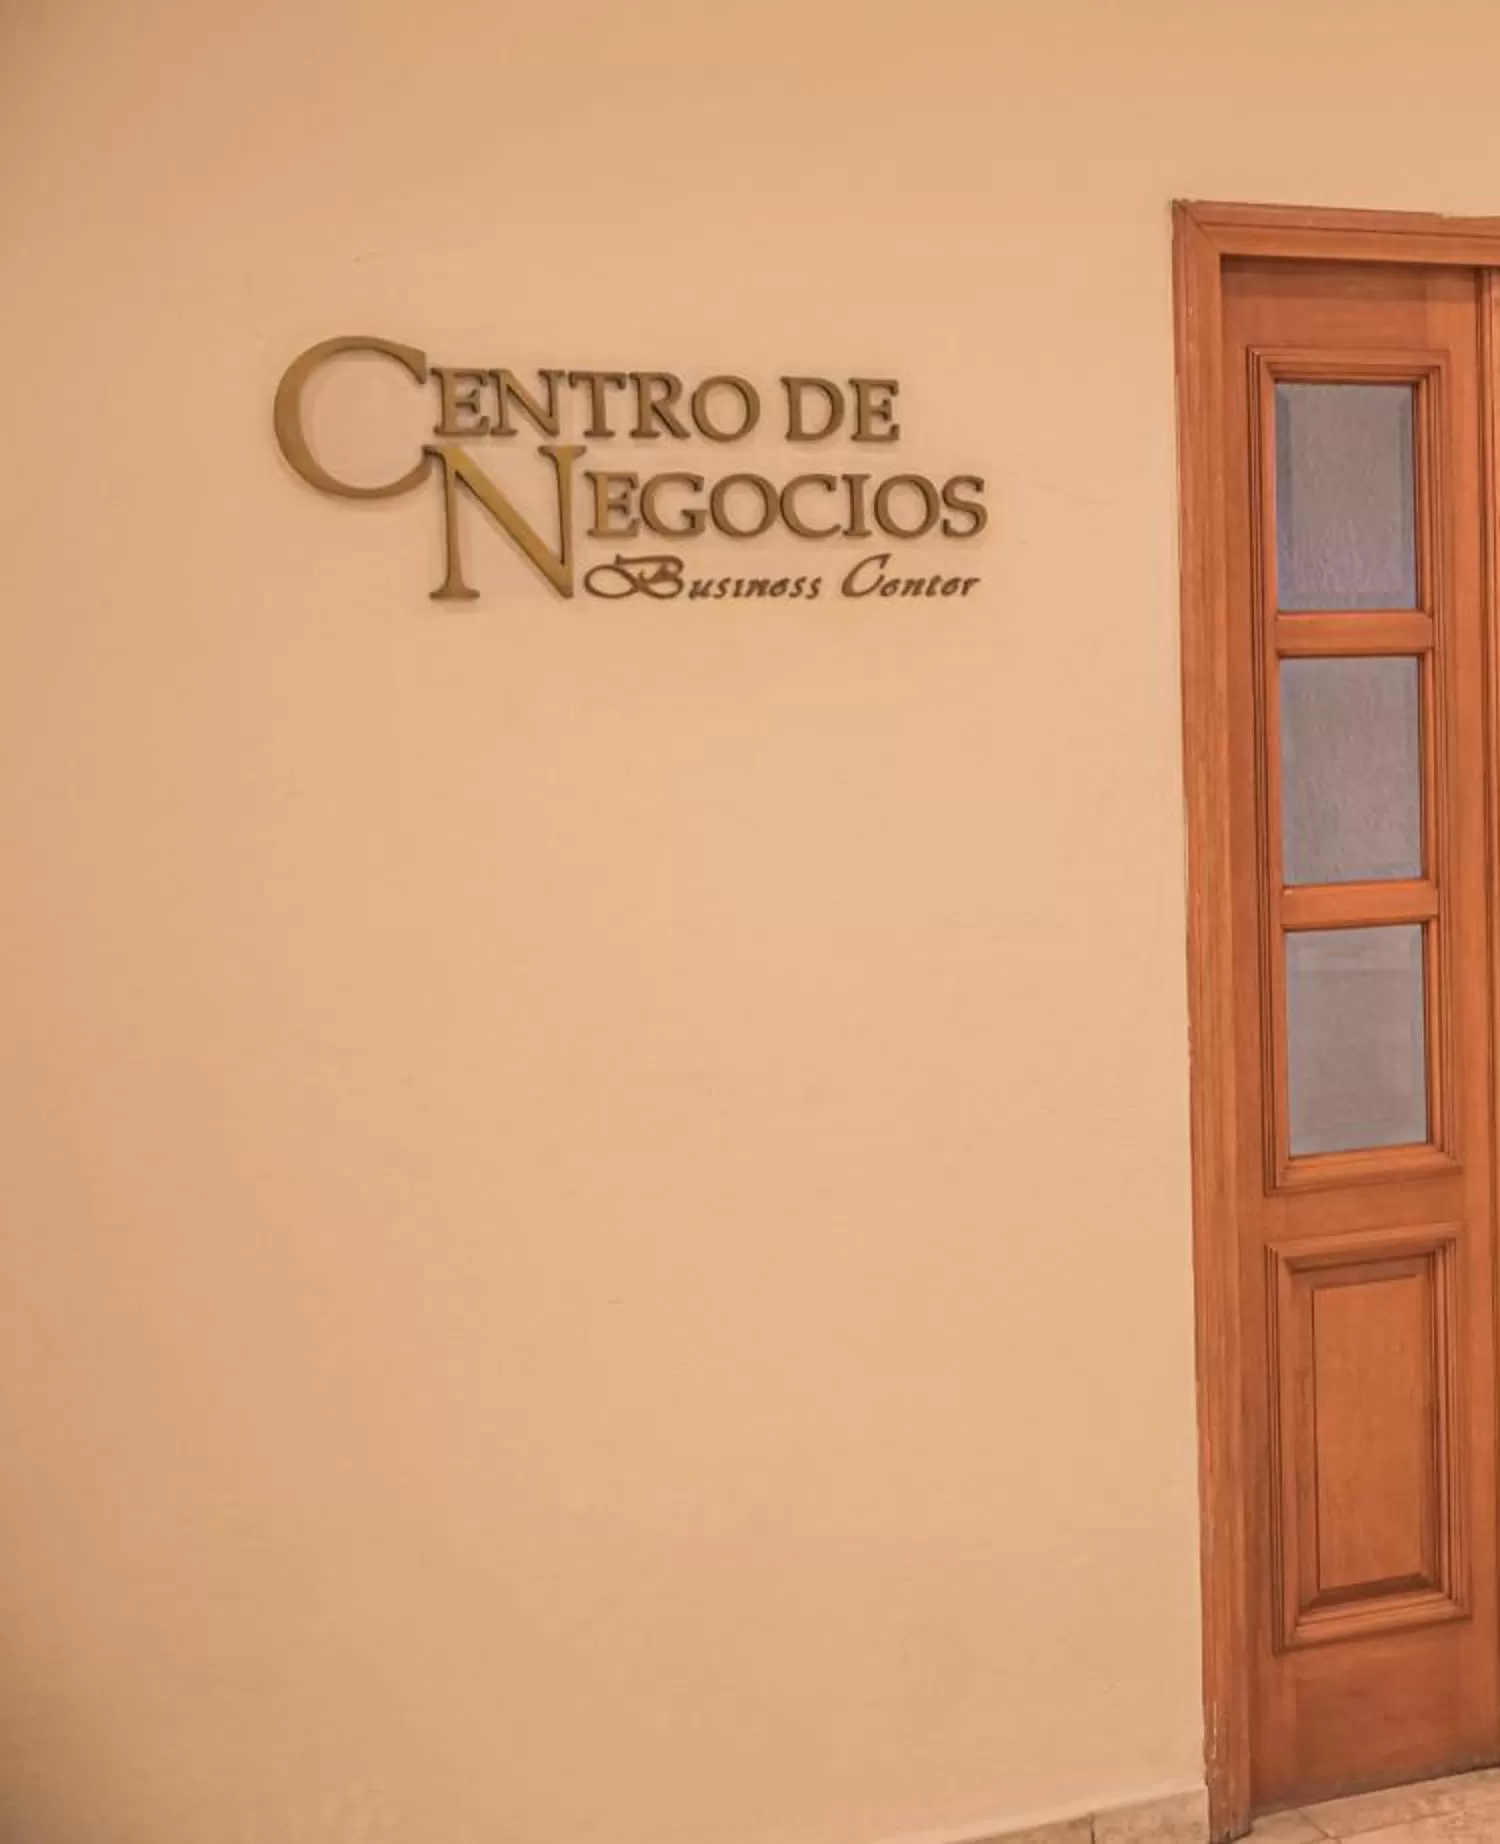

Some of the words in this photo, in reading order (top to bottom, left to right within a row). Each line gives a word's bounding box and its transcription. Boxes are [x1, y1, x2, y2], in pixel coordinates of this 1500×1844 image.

[781, 375, 900, 442] DE
[584, 554, 822, 599] Business
[841, 553, 981, 599] Center
